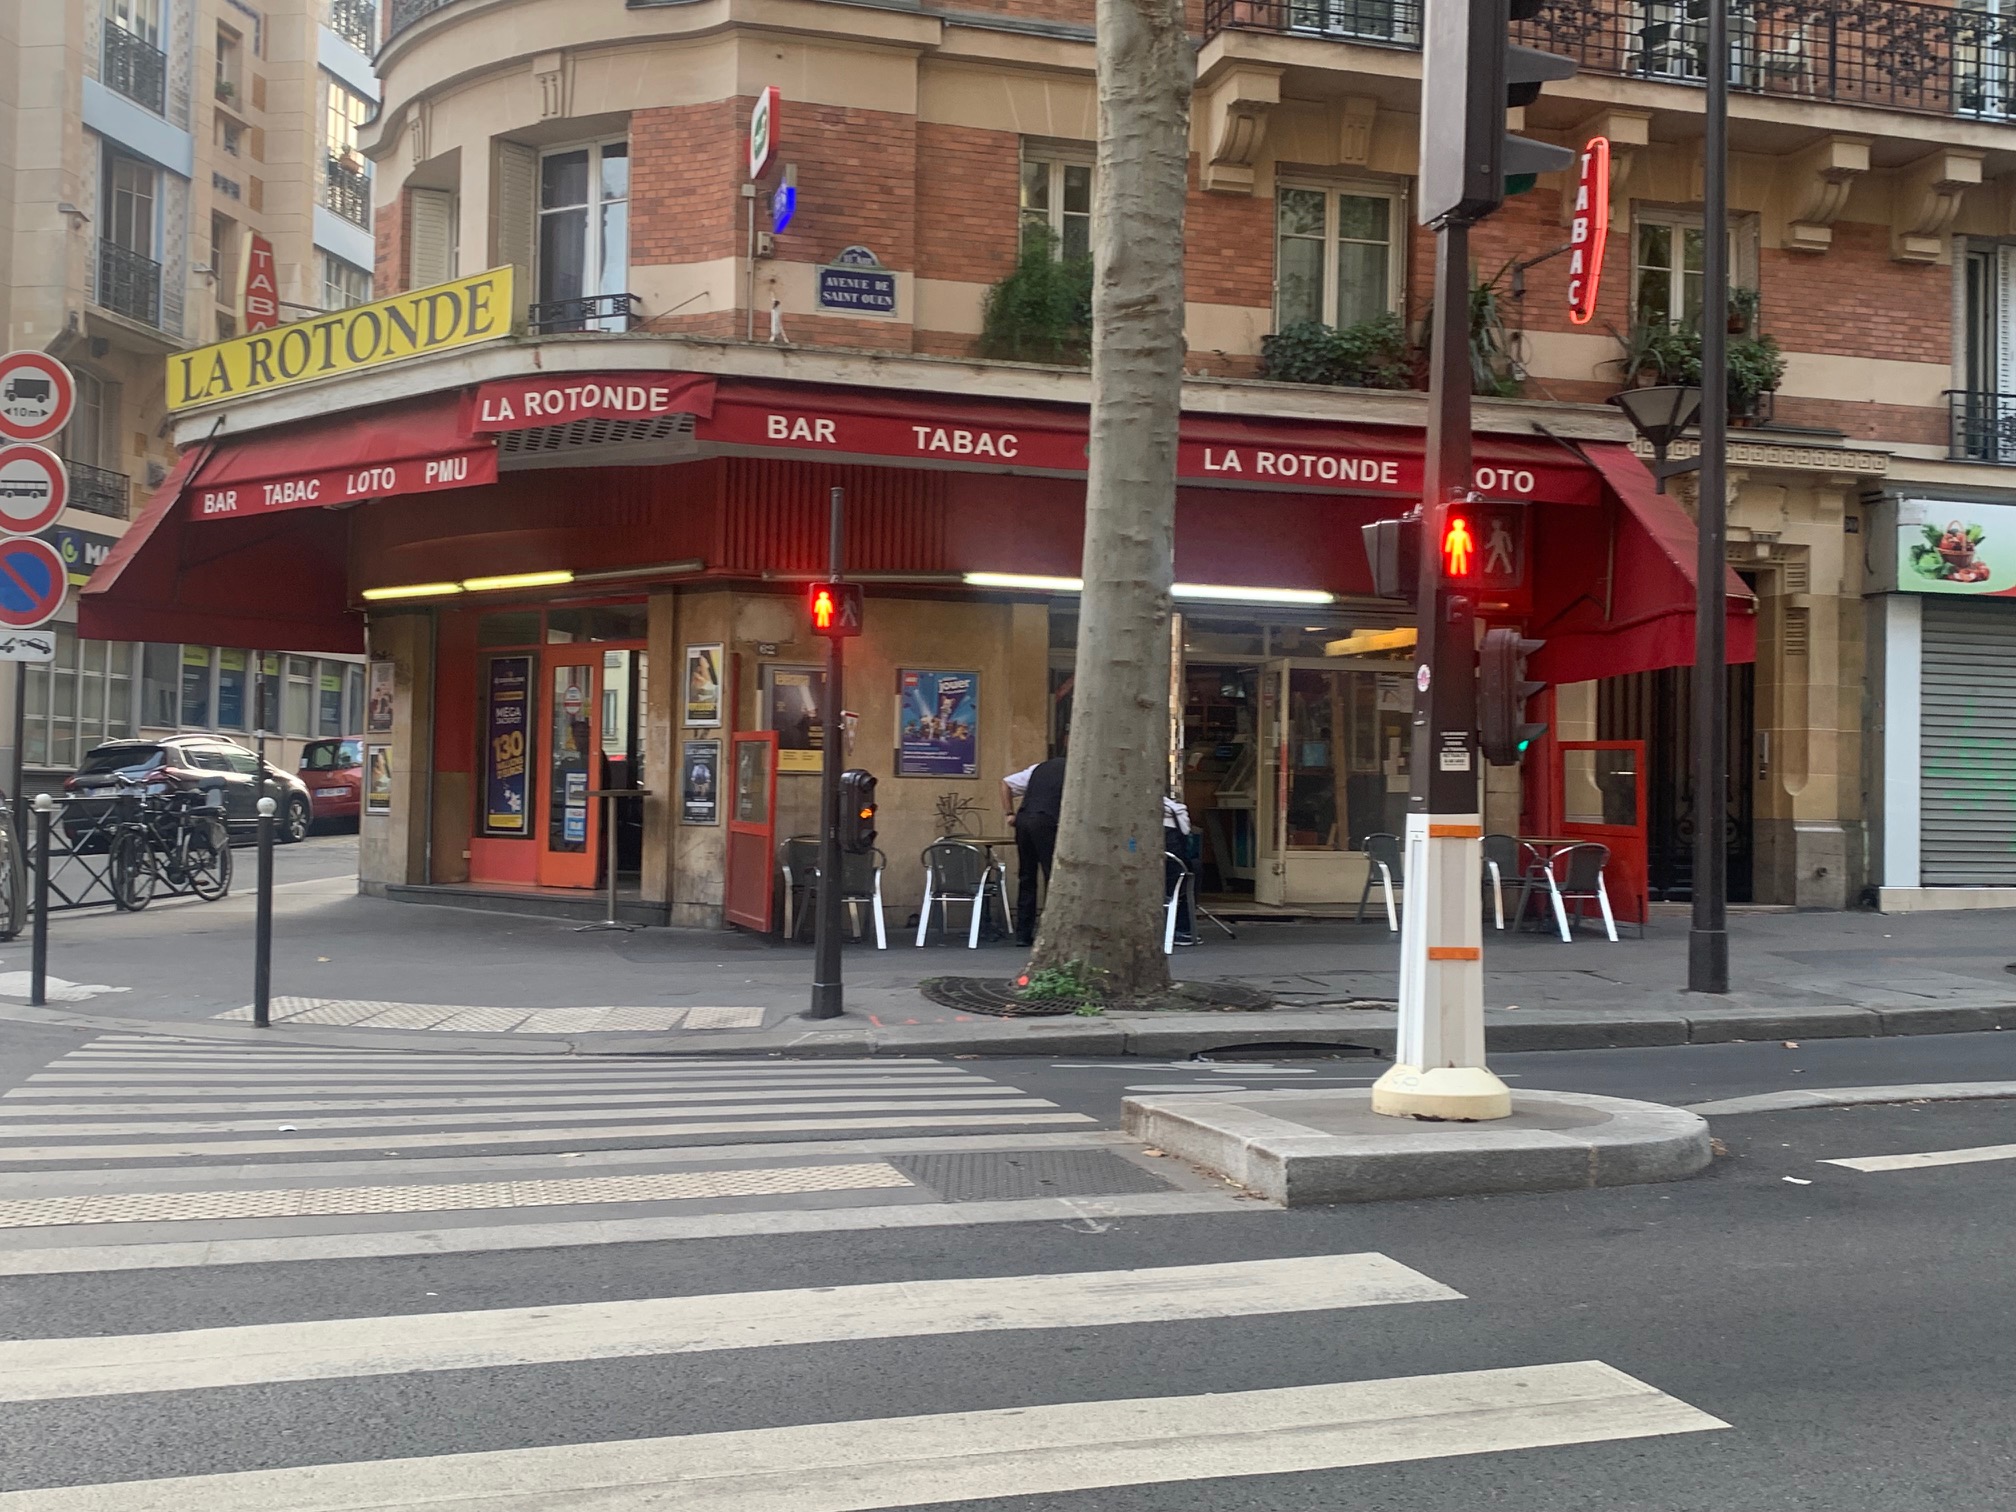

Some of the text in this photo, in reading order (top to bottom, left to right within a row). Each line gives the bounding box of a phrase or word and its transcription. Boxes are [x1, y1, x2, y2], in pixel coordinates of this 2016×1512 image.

[1568, 153, 1591, 305] TABAC
[248, 249, 275, 332] TABA
[822, 291, 892, 305] SAINT OUEN
[825, 277, 890, 291] AVENUE DE
[180, 280, 495, 403] LA ROTONDE
[481, 384, 669, 422] LA ROTONDE
[767, 415, 1018, 458] BAR TABAC
[203, 457, 468, 514] BAR TABAC LOTO PMU
[1204, 448, 1535, 493] LA ROTONDE OTO
[493, 730, 524, 762] 130
